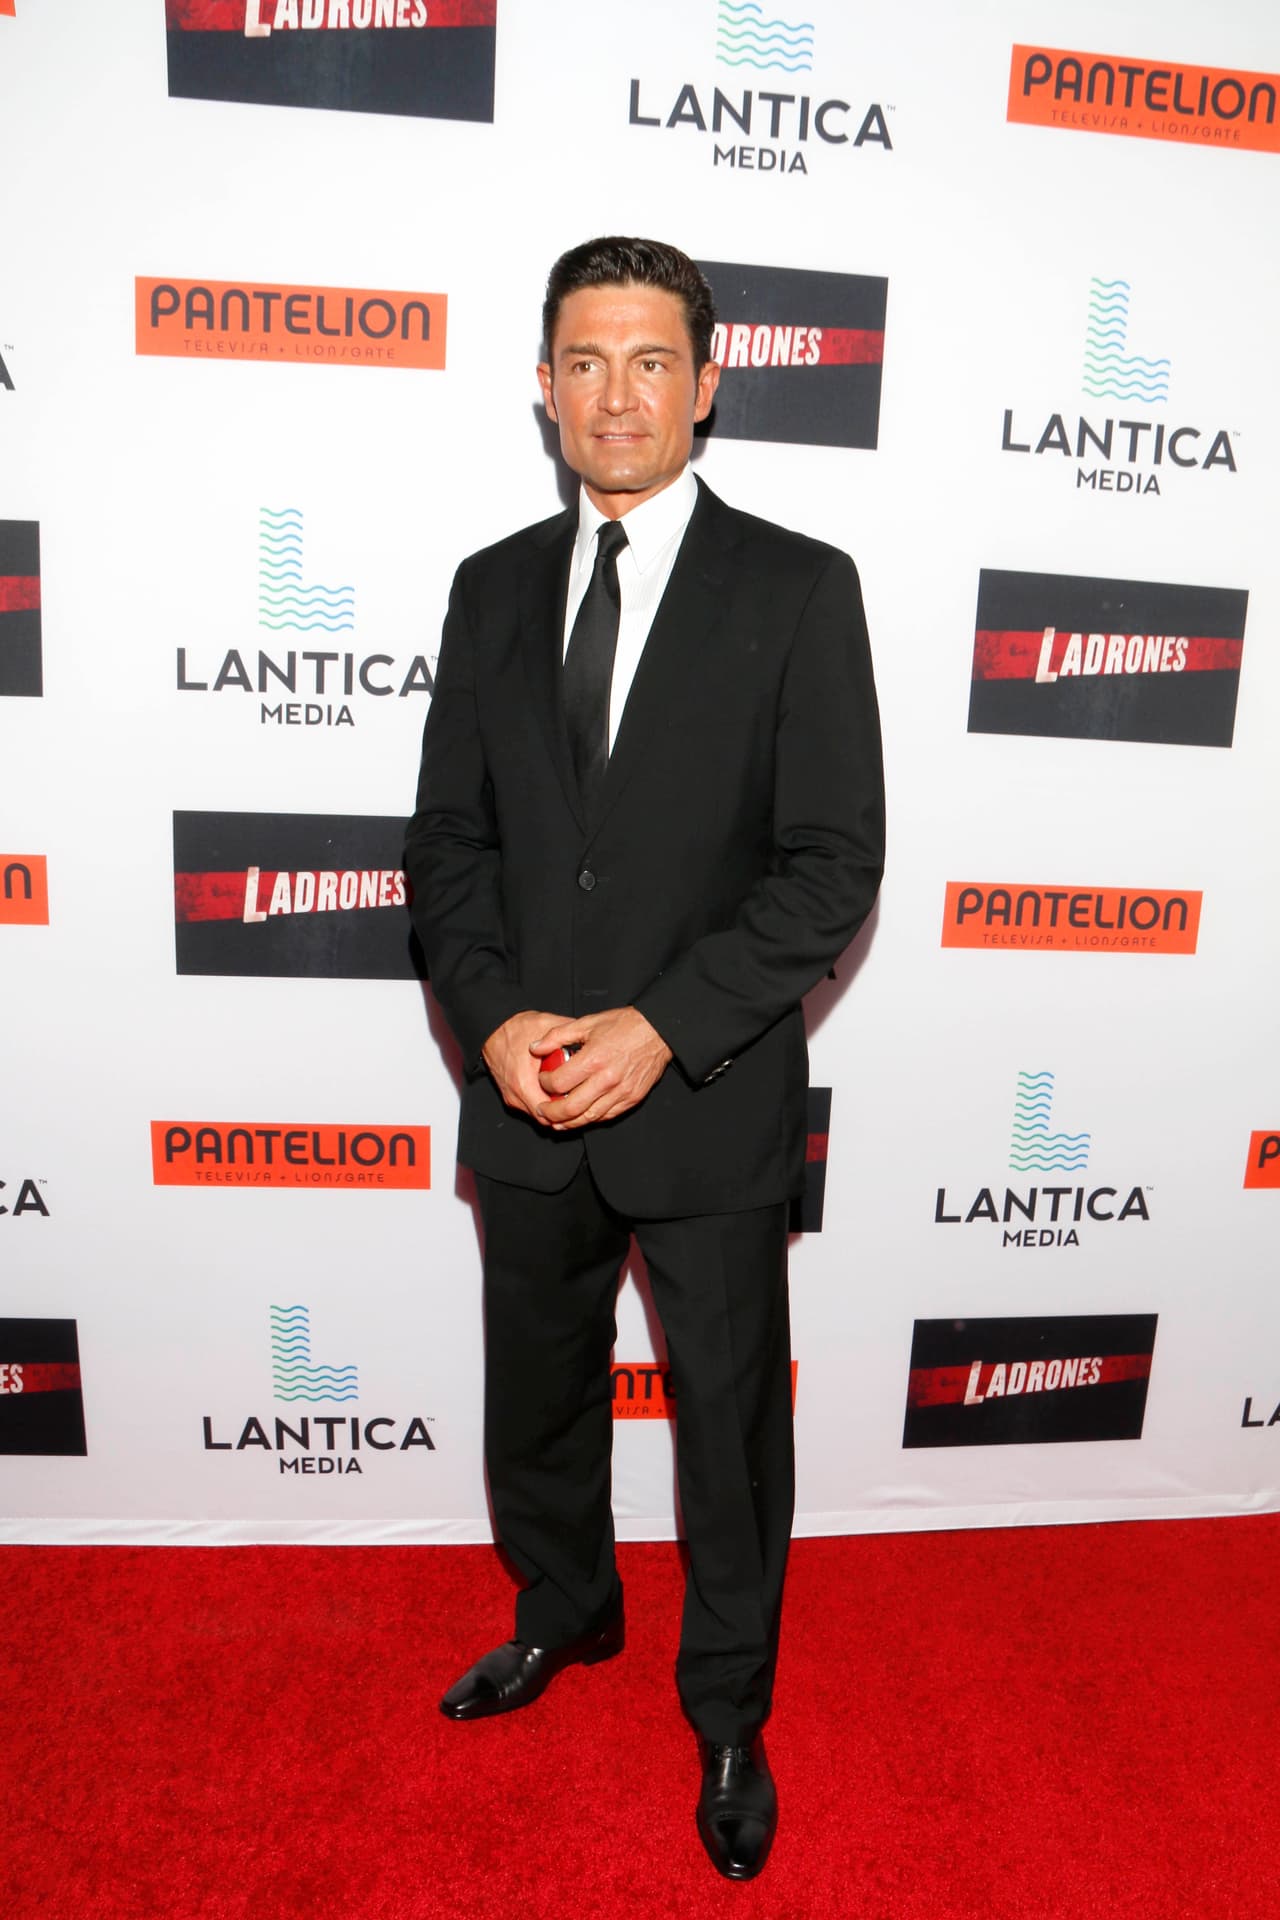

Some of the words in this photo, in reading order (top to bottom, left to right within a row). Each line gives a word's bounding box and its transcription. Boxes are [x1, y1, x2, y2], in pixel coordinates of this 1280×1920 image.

[244, 0, 428, 37] LADRONES
[1023, 53, 1277, 124] PANTELION
[629, 79, 893, 151] LANTICA
[1051, 109, 1128, 129] TELEVISA
[1152, 121, 1241, 141] LIONSGATE
[713, 144, 807, 174] MEDIA
[151, 284, 431, 341] PANTELION
[184, 339, 269, 353] TELEVISA
[295, 345, 395, 359] LIONSGATE
[710, 322, 822, 368] DRONES
[1002, 409, 1237, 473] LANTICA
[1076, 468, 1161, 495] MEDIA
[177, 647, 434, 698] LANTICA
[1034, 627, 1189, 684] LADRONES
[261, 703, 355, 726] MEDIA
[243, 866, 407, 923] LADRONES
[956, 887, 1188, 931] PANTELION
[983, 933, 1054, 946] TELEVISA
[1075, 935, 1157, 948] LIONSGATE
[164, 1126, 416, 1167] PANTELION
[194, 1171, 272, 1183] TELEVISA
[294, 1172, 385, 1184] LIONSGATE
[934, 1186, 1150, 1224] LANTICA
[1002, 1228, 1080, 1248] MEDIA
[964, 1357, 1103, 1405] LADRONES
[203, 1416, 436, 1451] LANTICA
[279, 1456, 363, 1475] MEDIA
